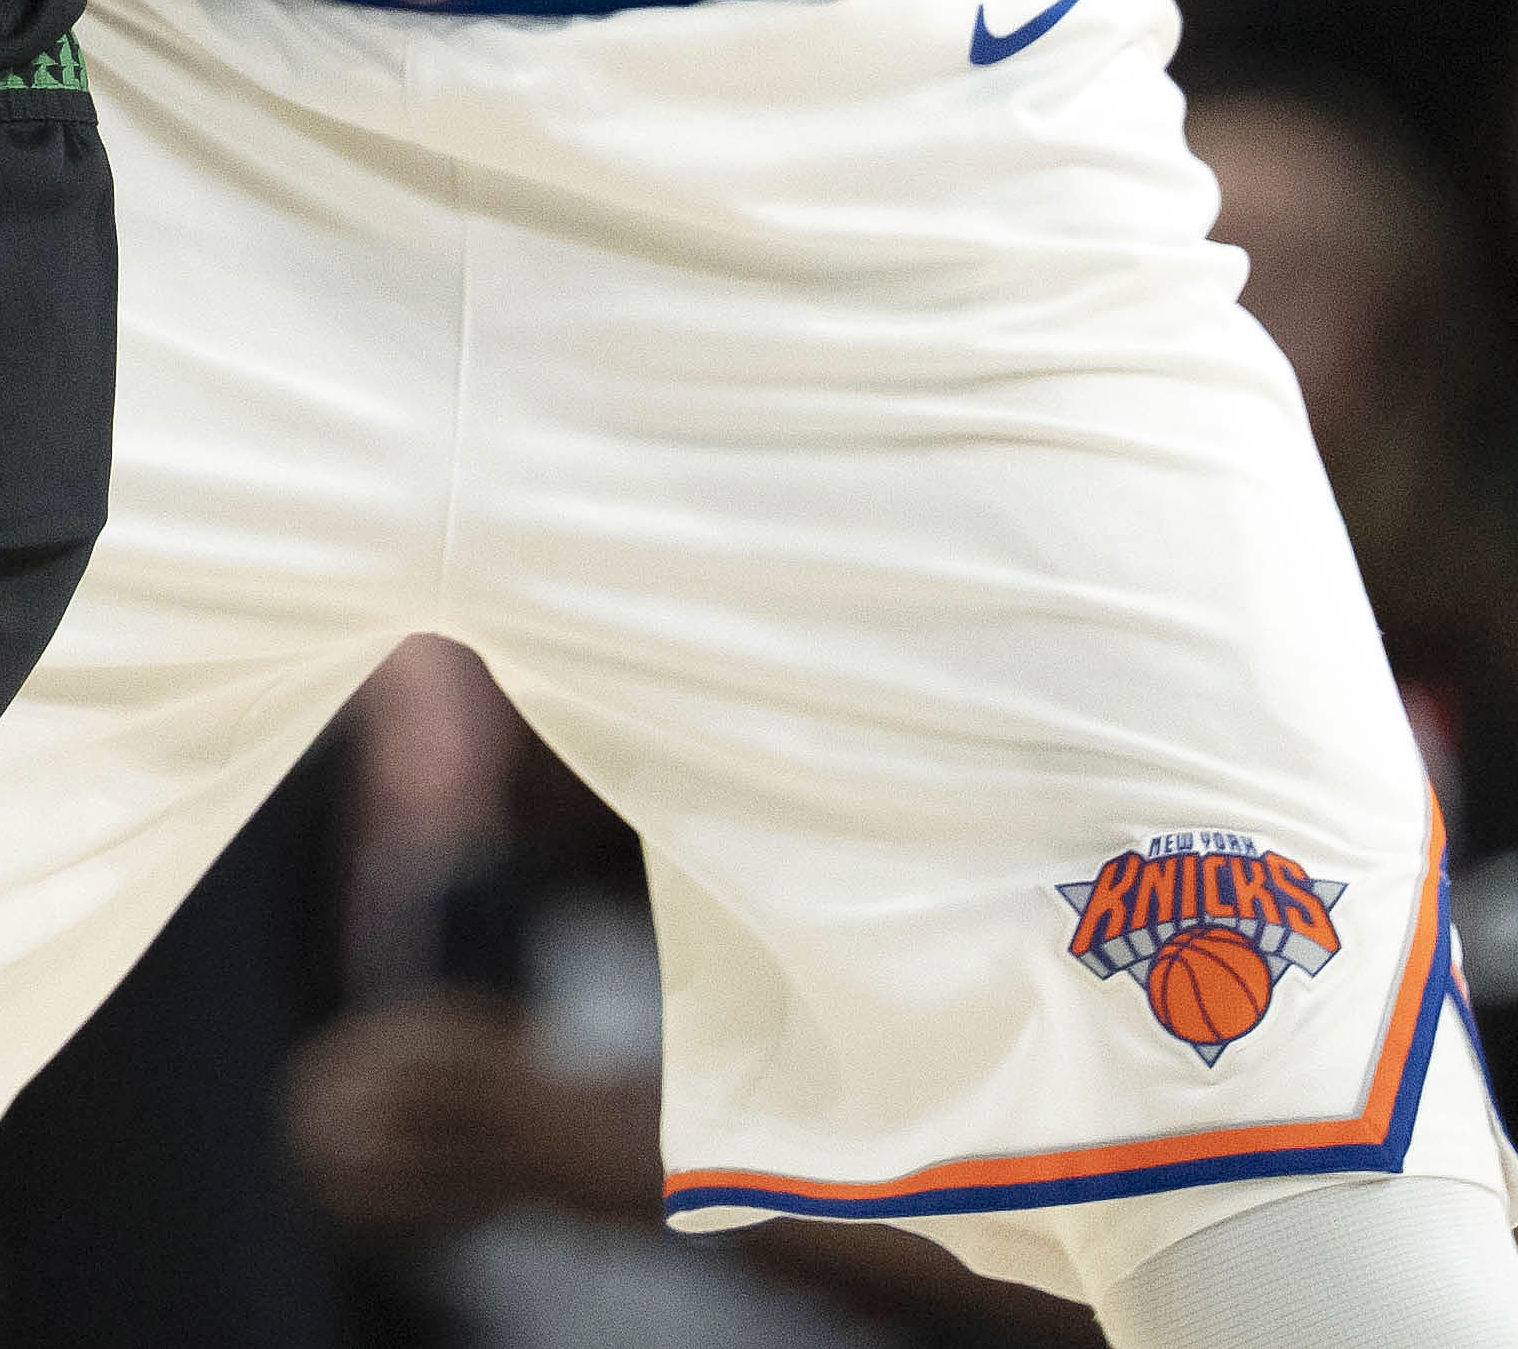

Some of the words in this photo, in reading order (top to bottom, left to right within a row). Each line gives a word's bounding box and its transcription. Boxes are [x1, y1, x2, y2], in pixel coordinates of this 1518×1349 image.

[1148, 832, 1194, 857] NEW
[1199, 830, 1257, 856] YORK
[1068, 851, 1342, 957] KNICKS
